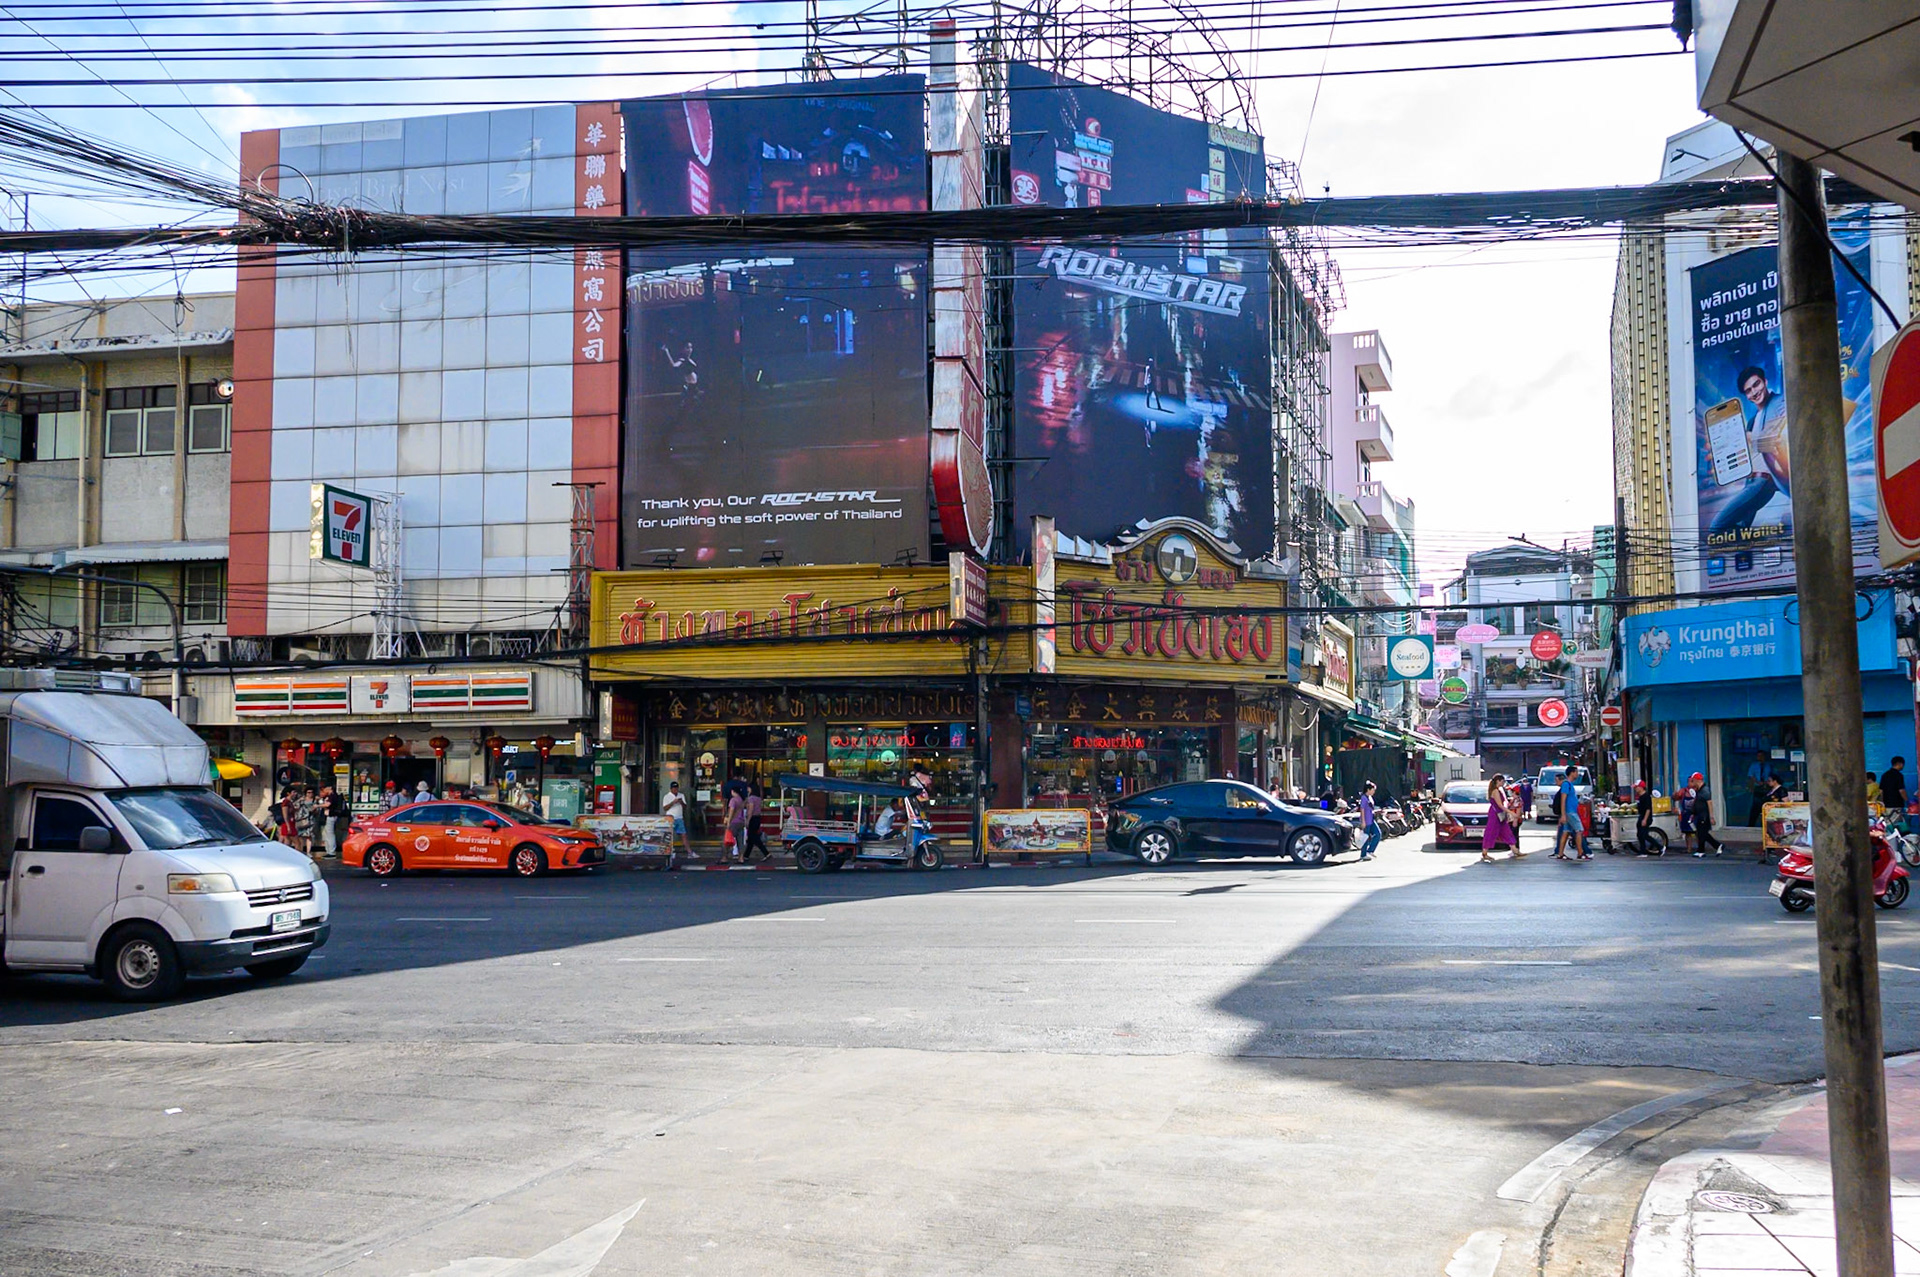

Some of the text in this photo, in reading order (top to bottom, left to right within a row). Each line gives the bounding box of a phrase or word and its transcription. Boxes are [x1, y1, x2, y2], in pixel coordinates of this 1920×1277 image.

[1037, 245, 1247, 317] ROCKSTAR
[1700, 282, 1757, 310] พลิกเงิน
[1701, 313, 1720, 332] ซื้อ
[1725, 307, 1751, 325] ขาย
[641, 490, 901, 513] Thank you, Our ROCKSTAR
[334, 500, 361, 560] 7
[637, 508, 902, 529] for uplifting the soft power of Thailand
[1707, 522, 1785, 545] Gold Wallet
[1679, 618, 1775, 645] Krungthai
[1396, 652, 1425, 662] Seafood
[1680, 646, 1724, 664] กรุงไทย
[600, 750, 615, 759] ATM
